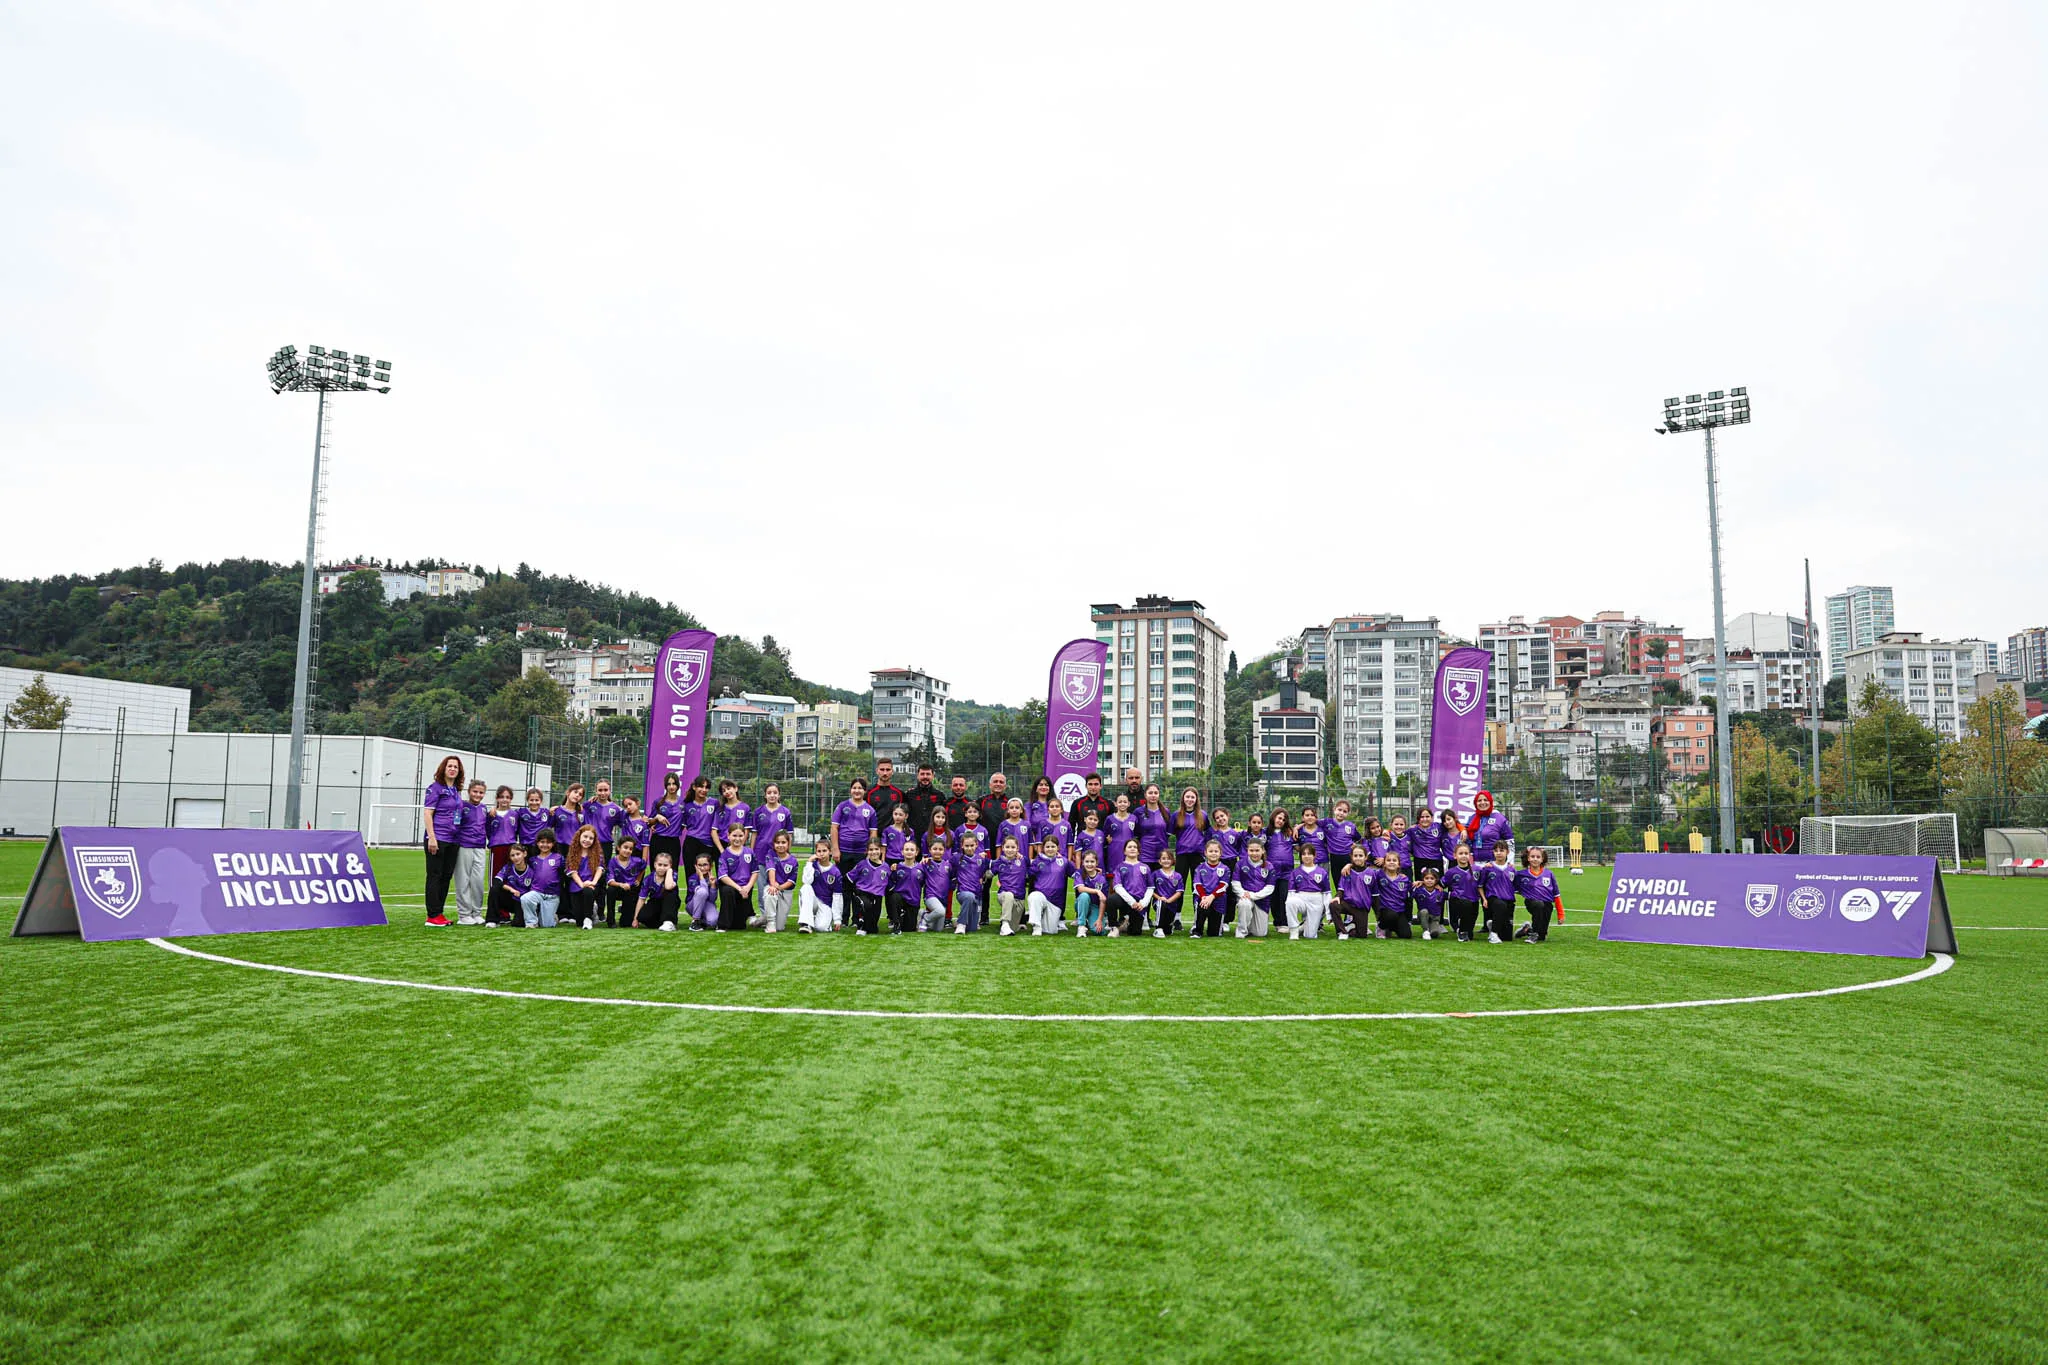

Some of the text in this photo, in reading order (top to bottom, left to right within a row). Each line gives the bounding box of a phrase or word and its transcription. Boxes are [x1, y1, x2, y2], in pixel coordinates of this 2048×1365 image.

[669, 704, 691, 739] 101
[1066, 736, 1084, 746] EFC
[1060, 782, 1082, 795] EA
[83, 855, 129, 863] SAMSUNSPOR
[212, 852, 366, 877] EQUALITY &
[220, 878, 375, 908] INCLUSION
[1615, 878, 1690, 896] SYMBOL
[107, 896, 125, 904] 1965
[1797, 899, 1815, 907] EFC
[1847, 895, 1871, 906] EA
[1612, 897, 1717, 917] OF CHANGE
